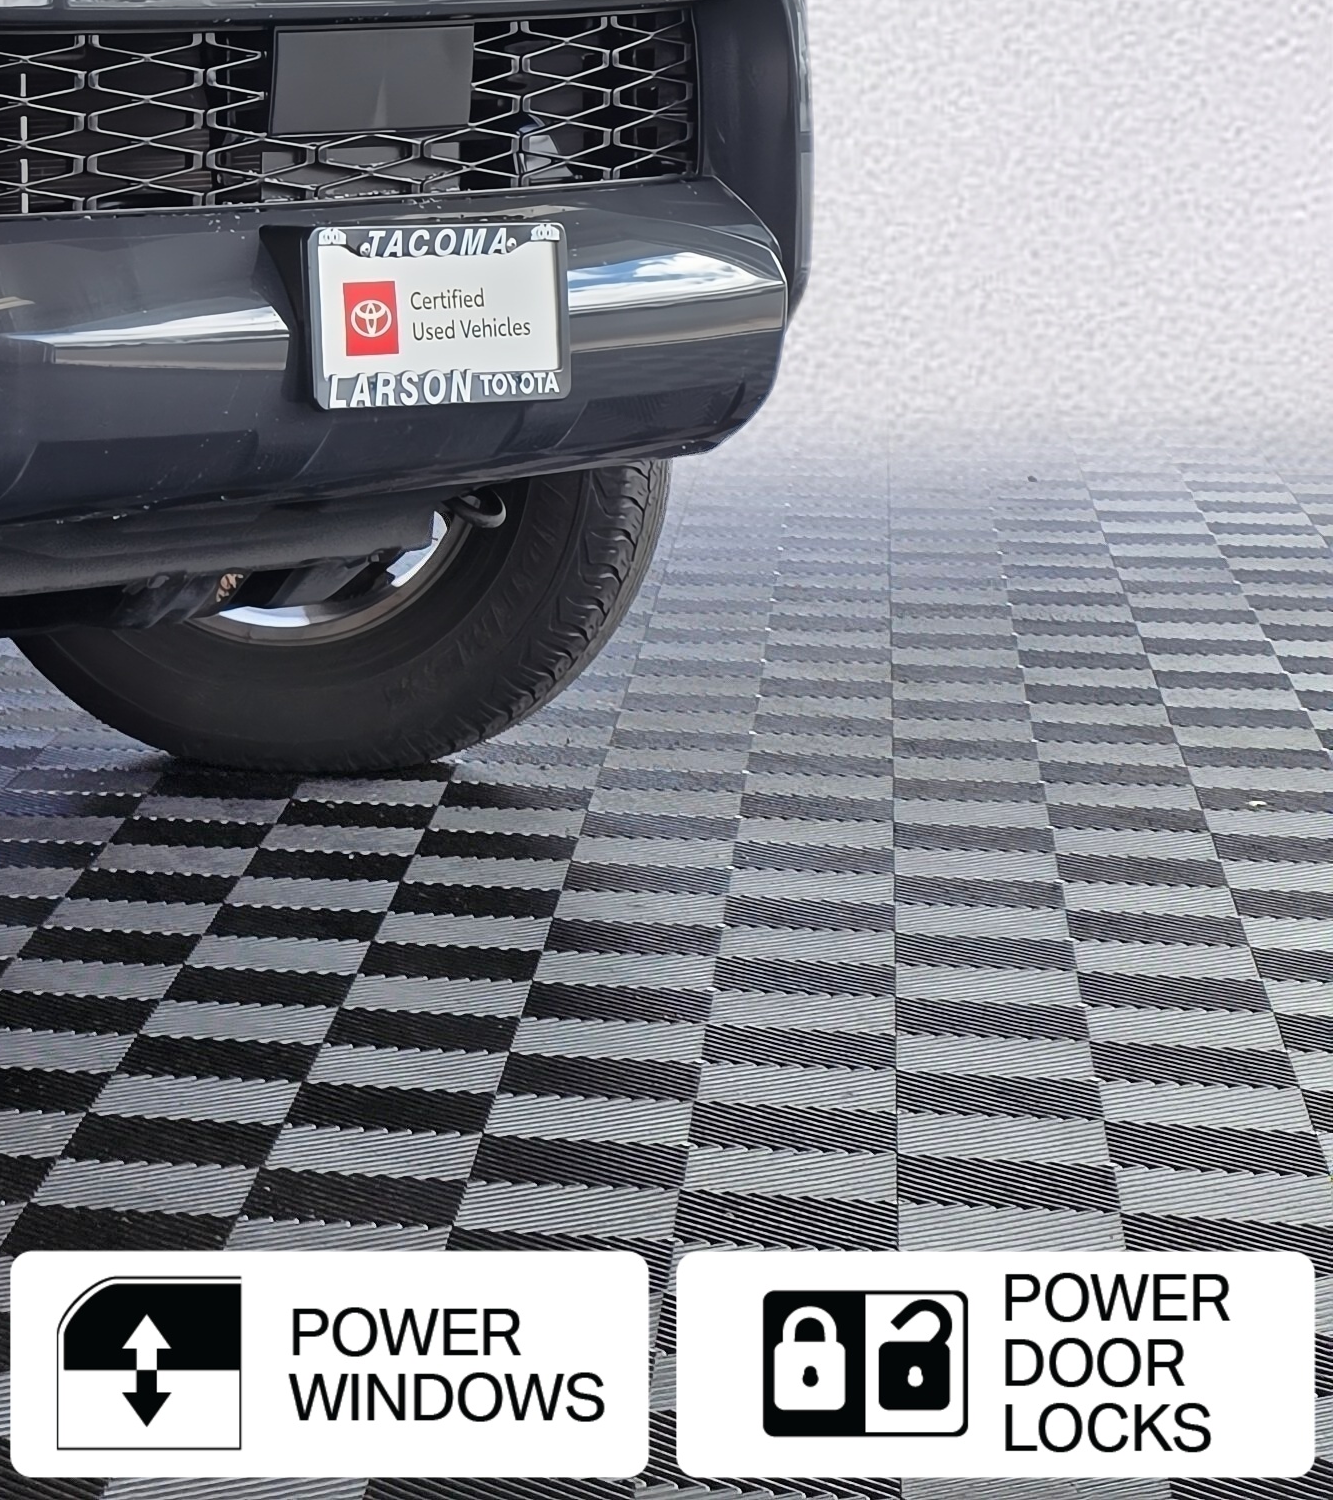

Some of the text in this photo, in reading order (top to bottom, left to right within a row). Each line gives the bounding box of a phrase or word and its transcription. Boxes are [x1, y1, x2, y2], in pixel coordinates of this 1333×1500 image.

[367, 227, 508, 258] TACOMA
[410, 288, 485, 311] Certified
[412, 317, 531, 341] Used Vehicles
[328, 369, 560, 409] LARSON TOYOTA
